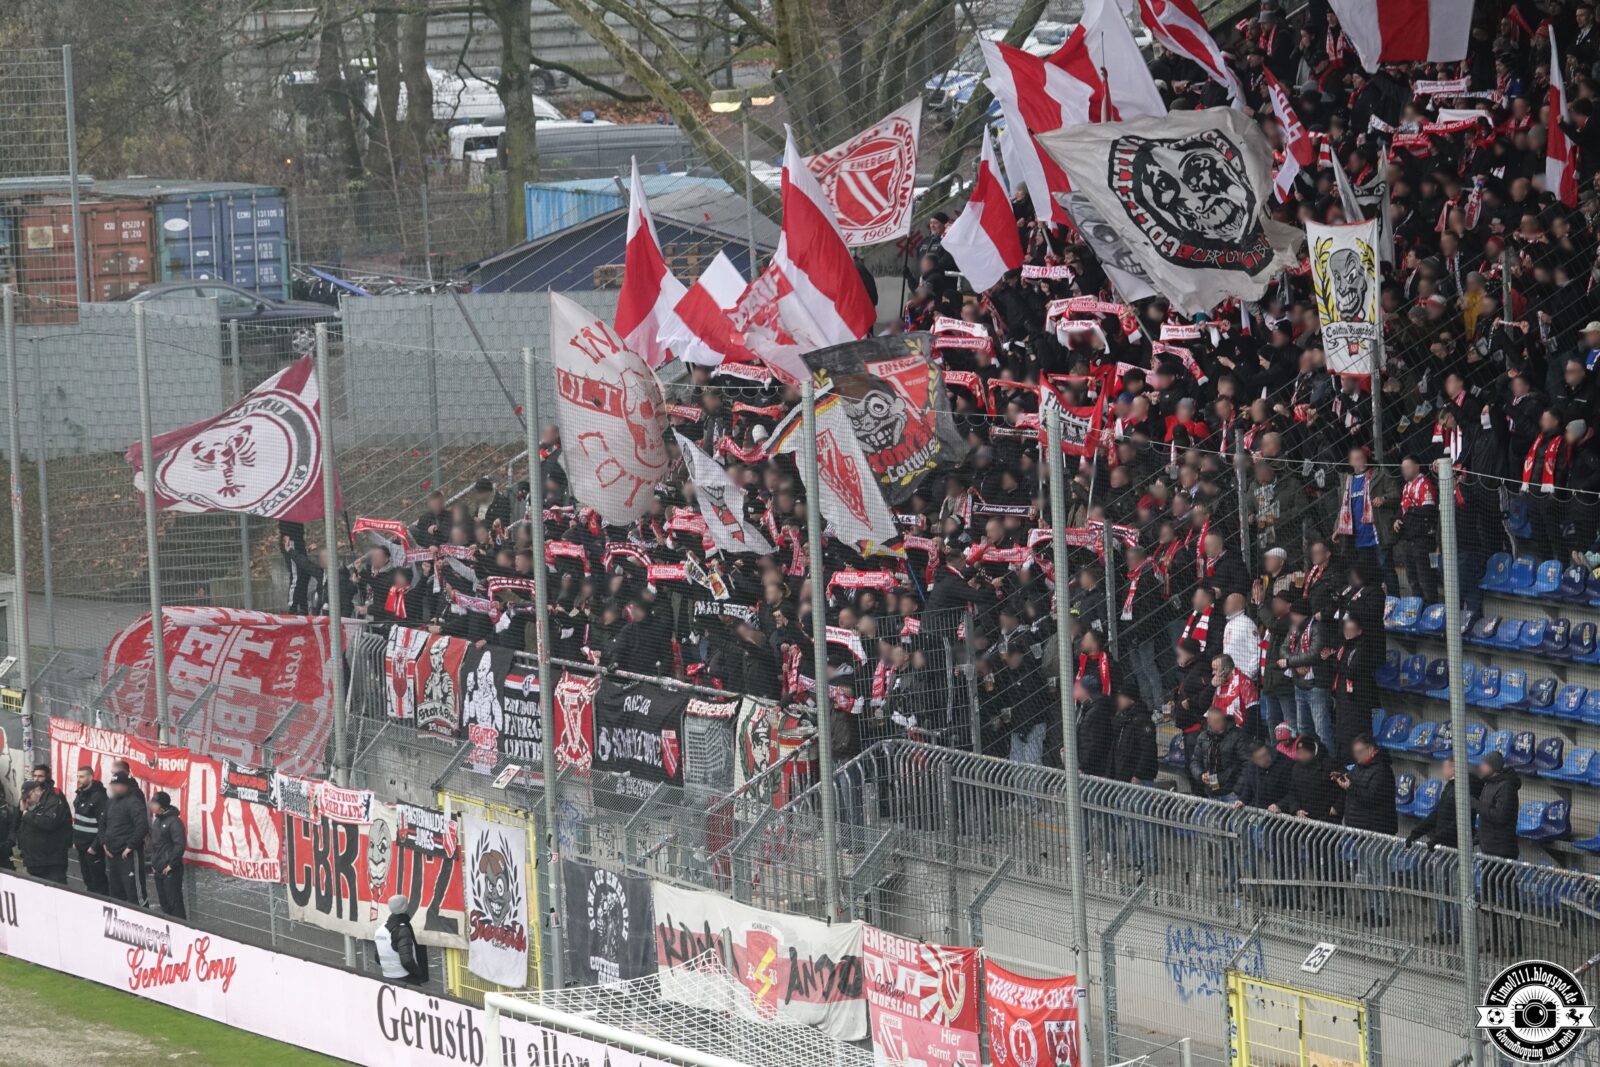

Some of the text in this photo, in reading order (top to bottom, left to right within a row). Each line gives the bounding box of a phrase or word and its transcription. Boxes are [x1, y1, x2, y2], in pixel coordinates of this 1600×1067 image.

[850, 152, 893, 171] ENERGIE
[860, 224, 893, 242] 1966
[158, 757, 188, 772] FRONT
[233, 861, 281, 881] ENERGIE
[102, 906, 173, 958] Zimmerei
[863, 925, 919, 965] ENERGIE
[127, 936, 237, 993] Gerhard Erny
[1305, 948, 1326, 969] 25
[376, 984, 517, 1067] Gerüstbu
[940, 1028, 961, 1047] Hier
